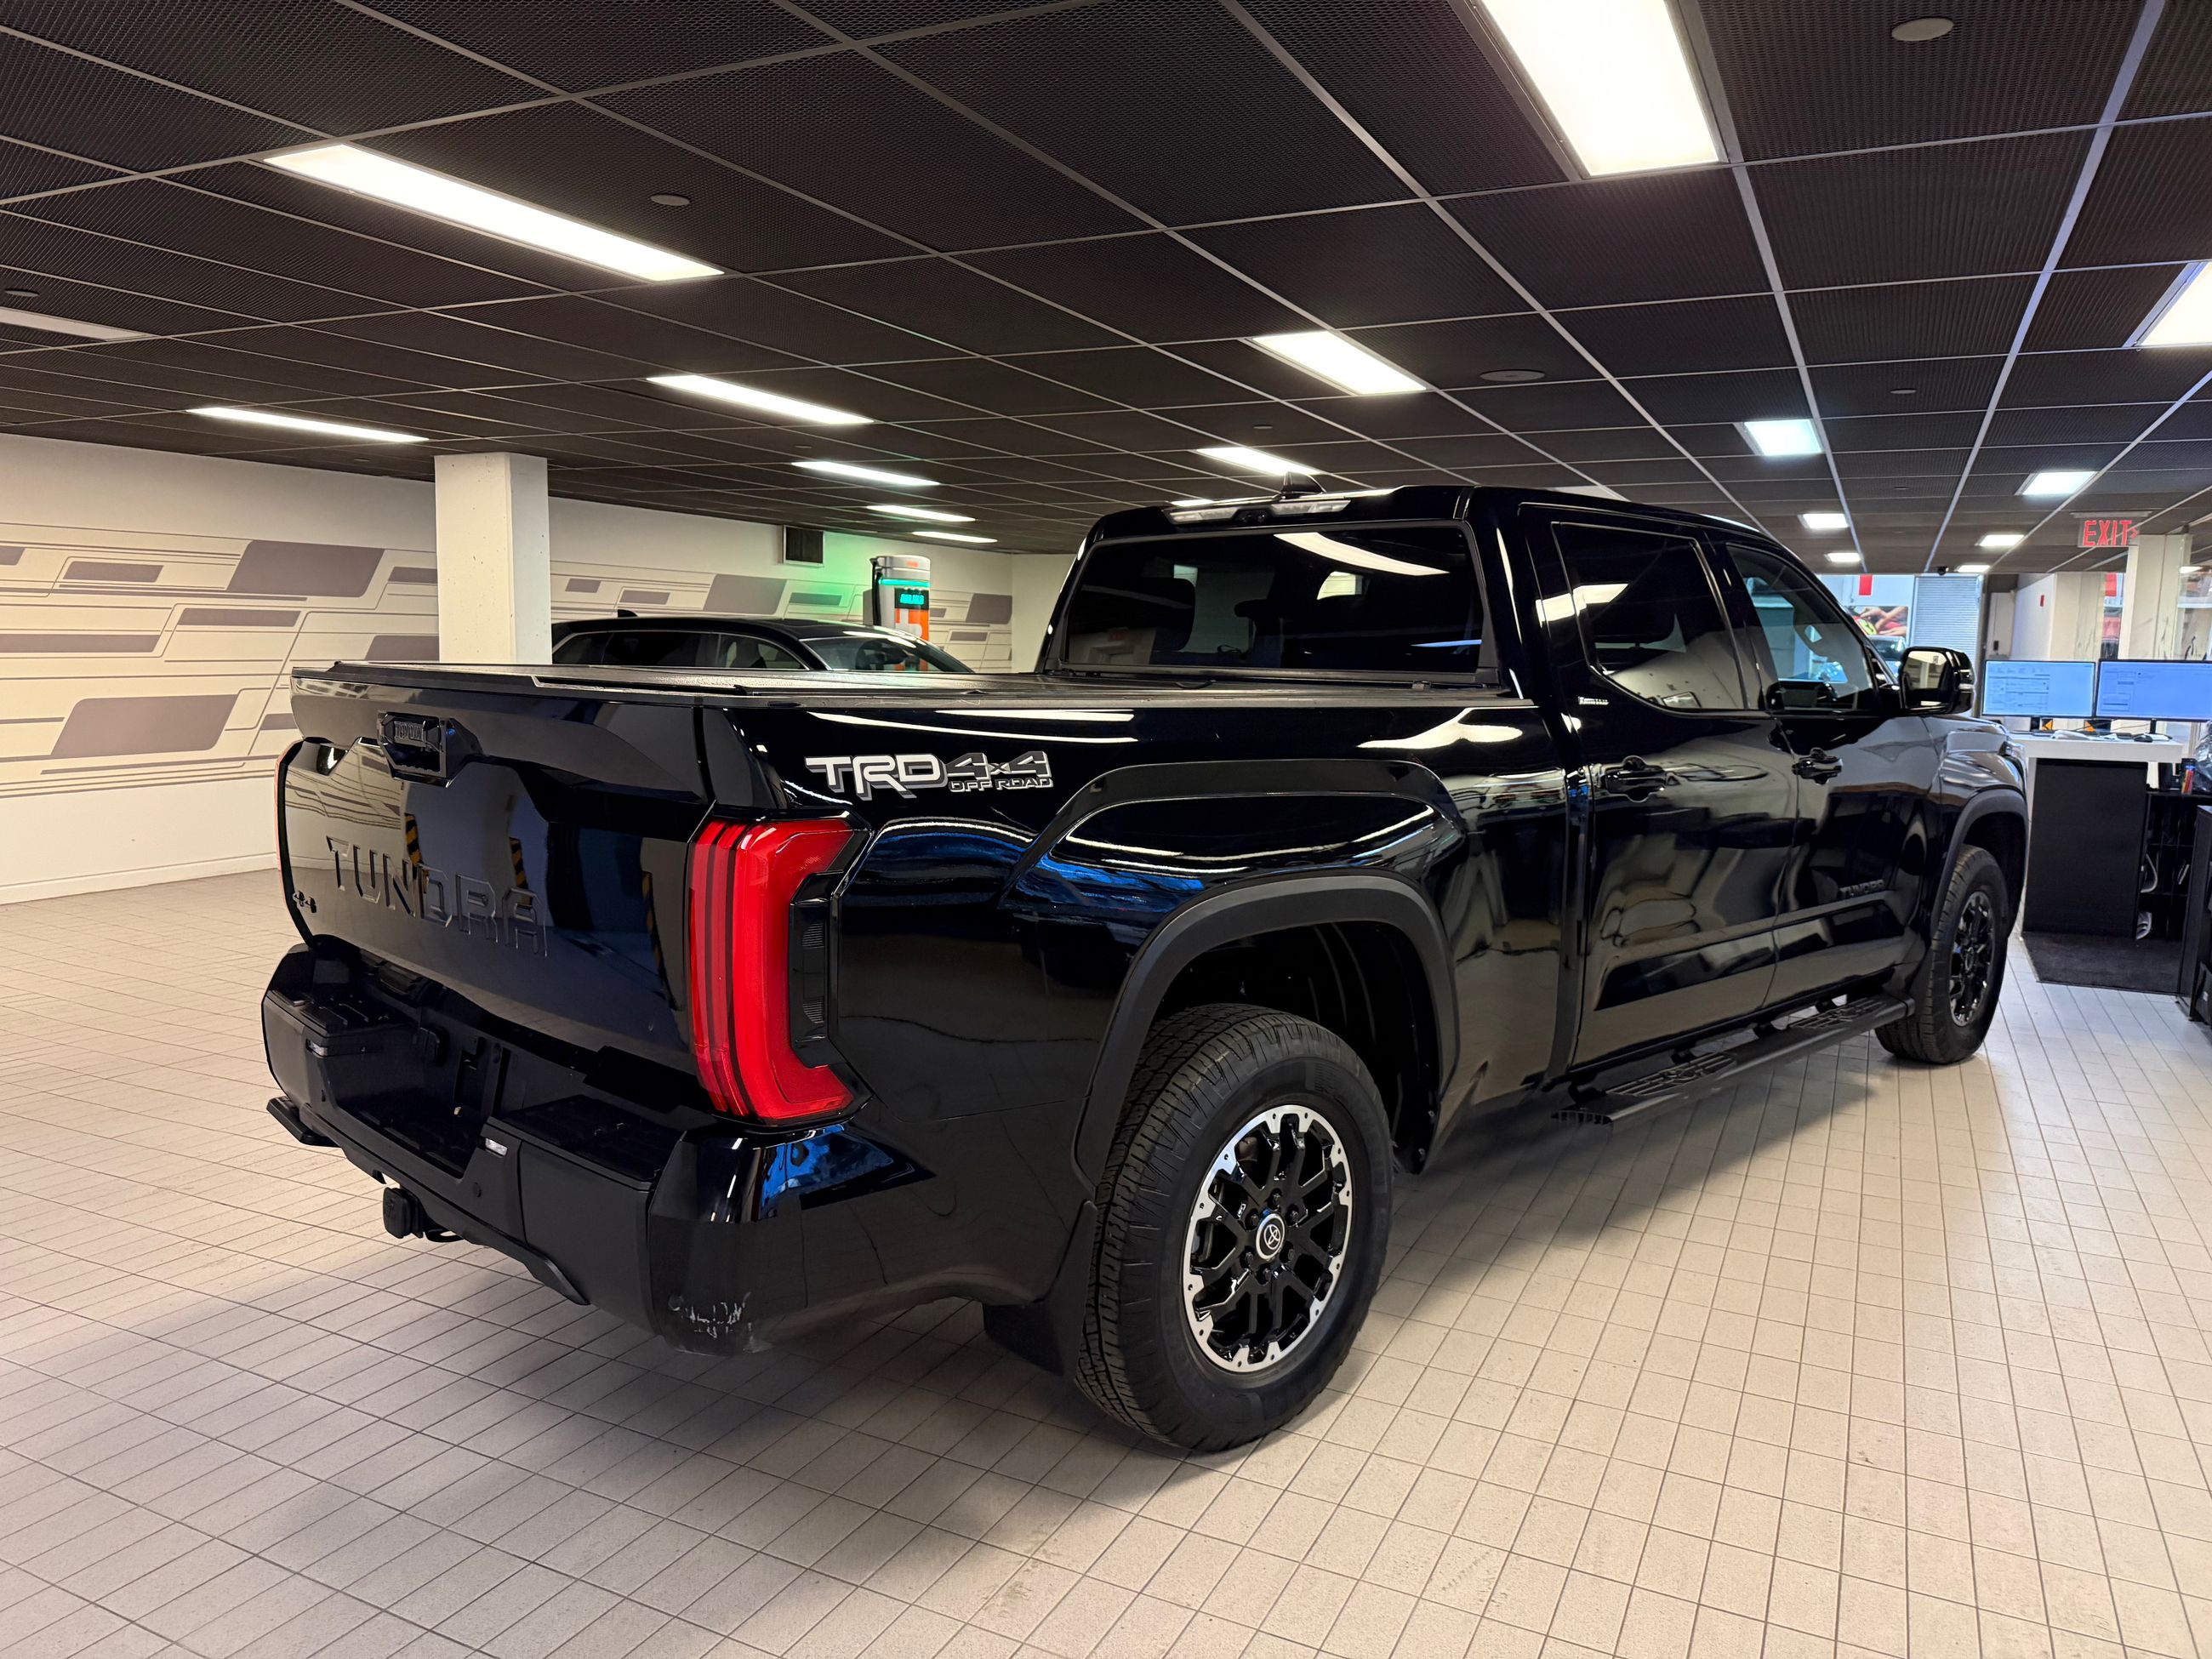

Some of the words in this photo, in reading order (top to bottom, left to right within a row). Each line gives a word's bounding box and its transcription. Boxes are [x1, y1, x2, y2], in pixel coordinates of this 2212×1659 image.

[2083, 520, 2132, 546] EXIT
[805, 754, 948, 801] TRD
[946, 751, 1053, 780] 4x4
[949, 780, 992, 792] OFF
[995, 778, 1054, 791] ROAD
[326, 835, 548, 957] TUNDRA
